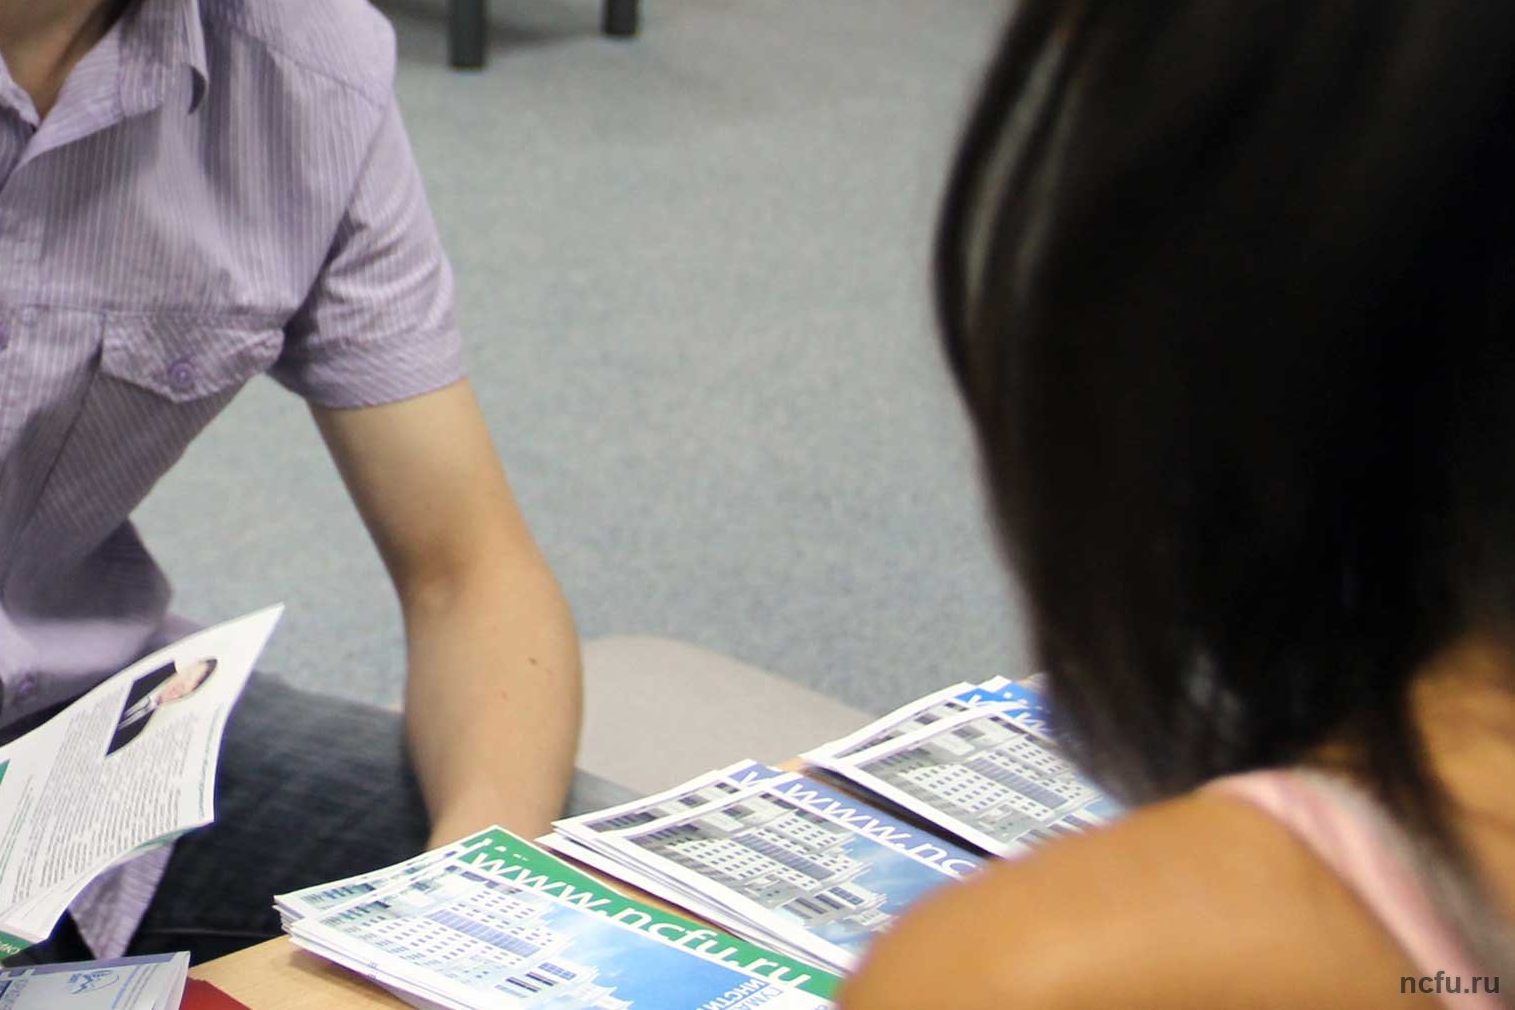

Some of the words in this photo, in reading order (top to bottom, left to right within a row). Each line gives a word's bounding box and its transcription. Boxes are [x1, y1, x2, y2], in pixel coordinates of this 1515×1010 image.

[785, 783, 978, 880] www.nc
[471, 852, 812, 988] www.ncfu.ru
[696, 978, 766, 1010] ИНСТИ
